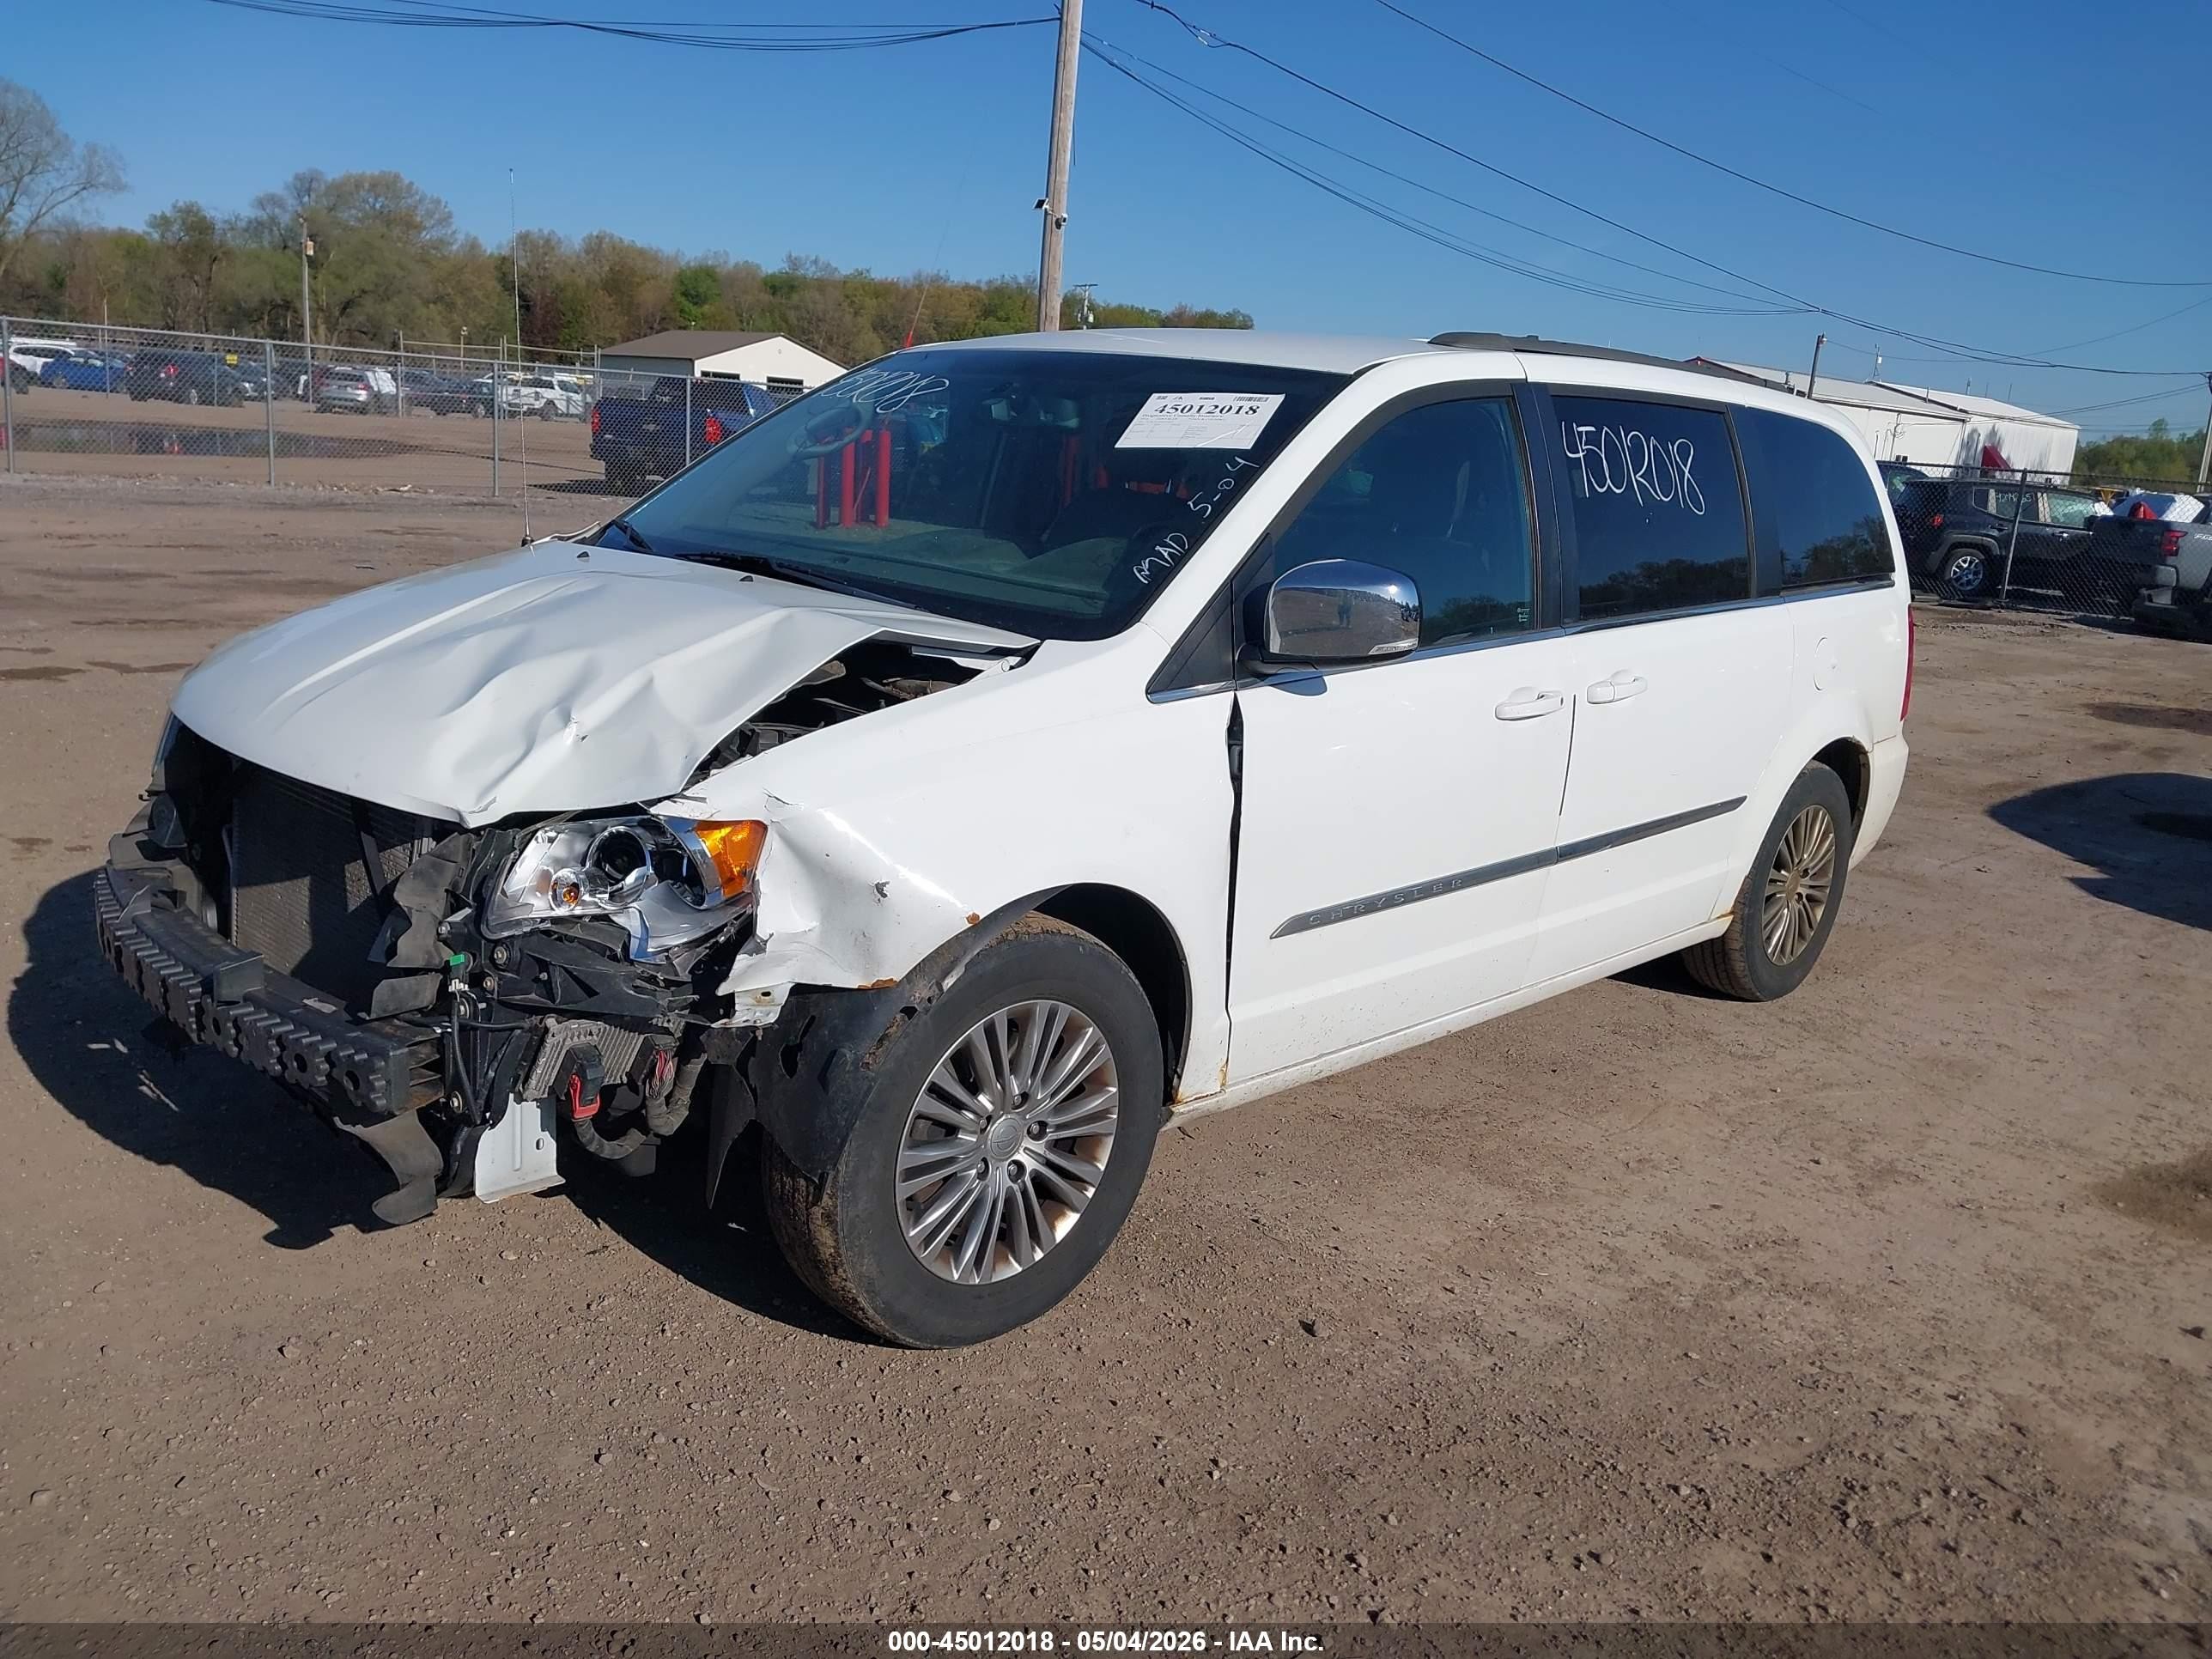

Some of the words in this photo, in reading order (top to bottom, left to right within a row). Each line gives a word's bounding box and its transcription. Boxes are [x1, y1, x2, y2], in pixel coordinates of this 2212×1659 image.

[1154, 404, 1261, 416] 45012018
[1187, 456, 1261, 519] 5-04
[1561, 421, 1705, 515] 45012018
[1309, 878, 1462, 925] CHRYSLER
